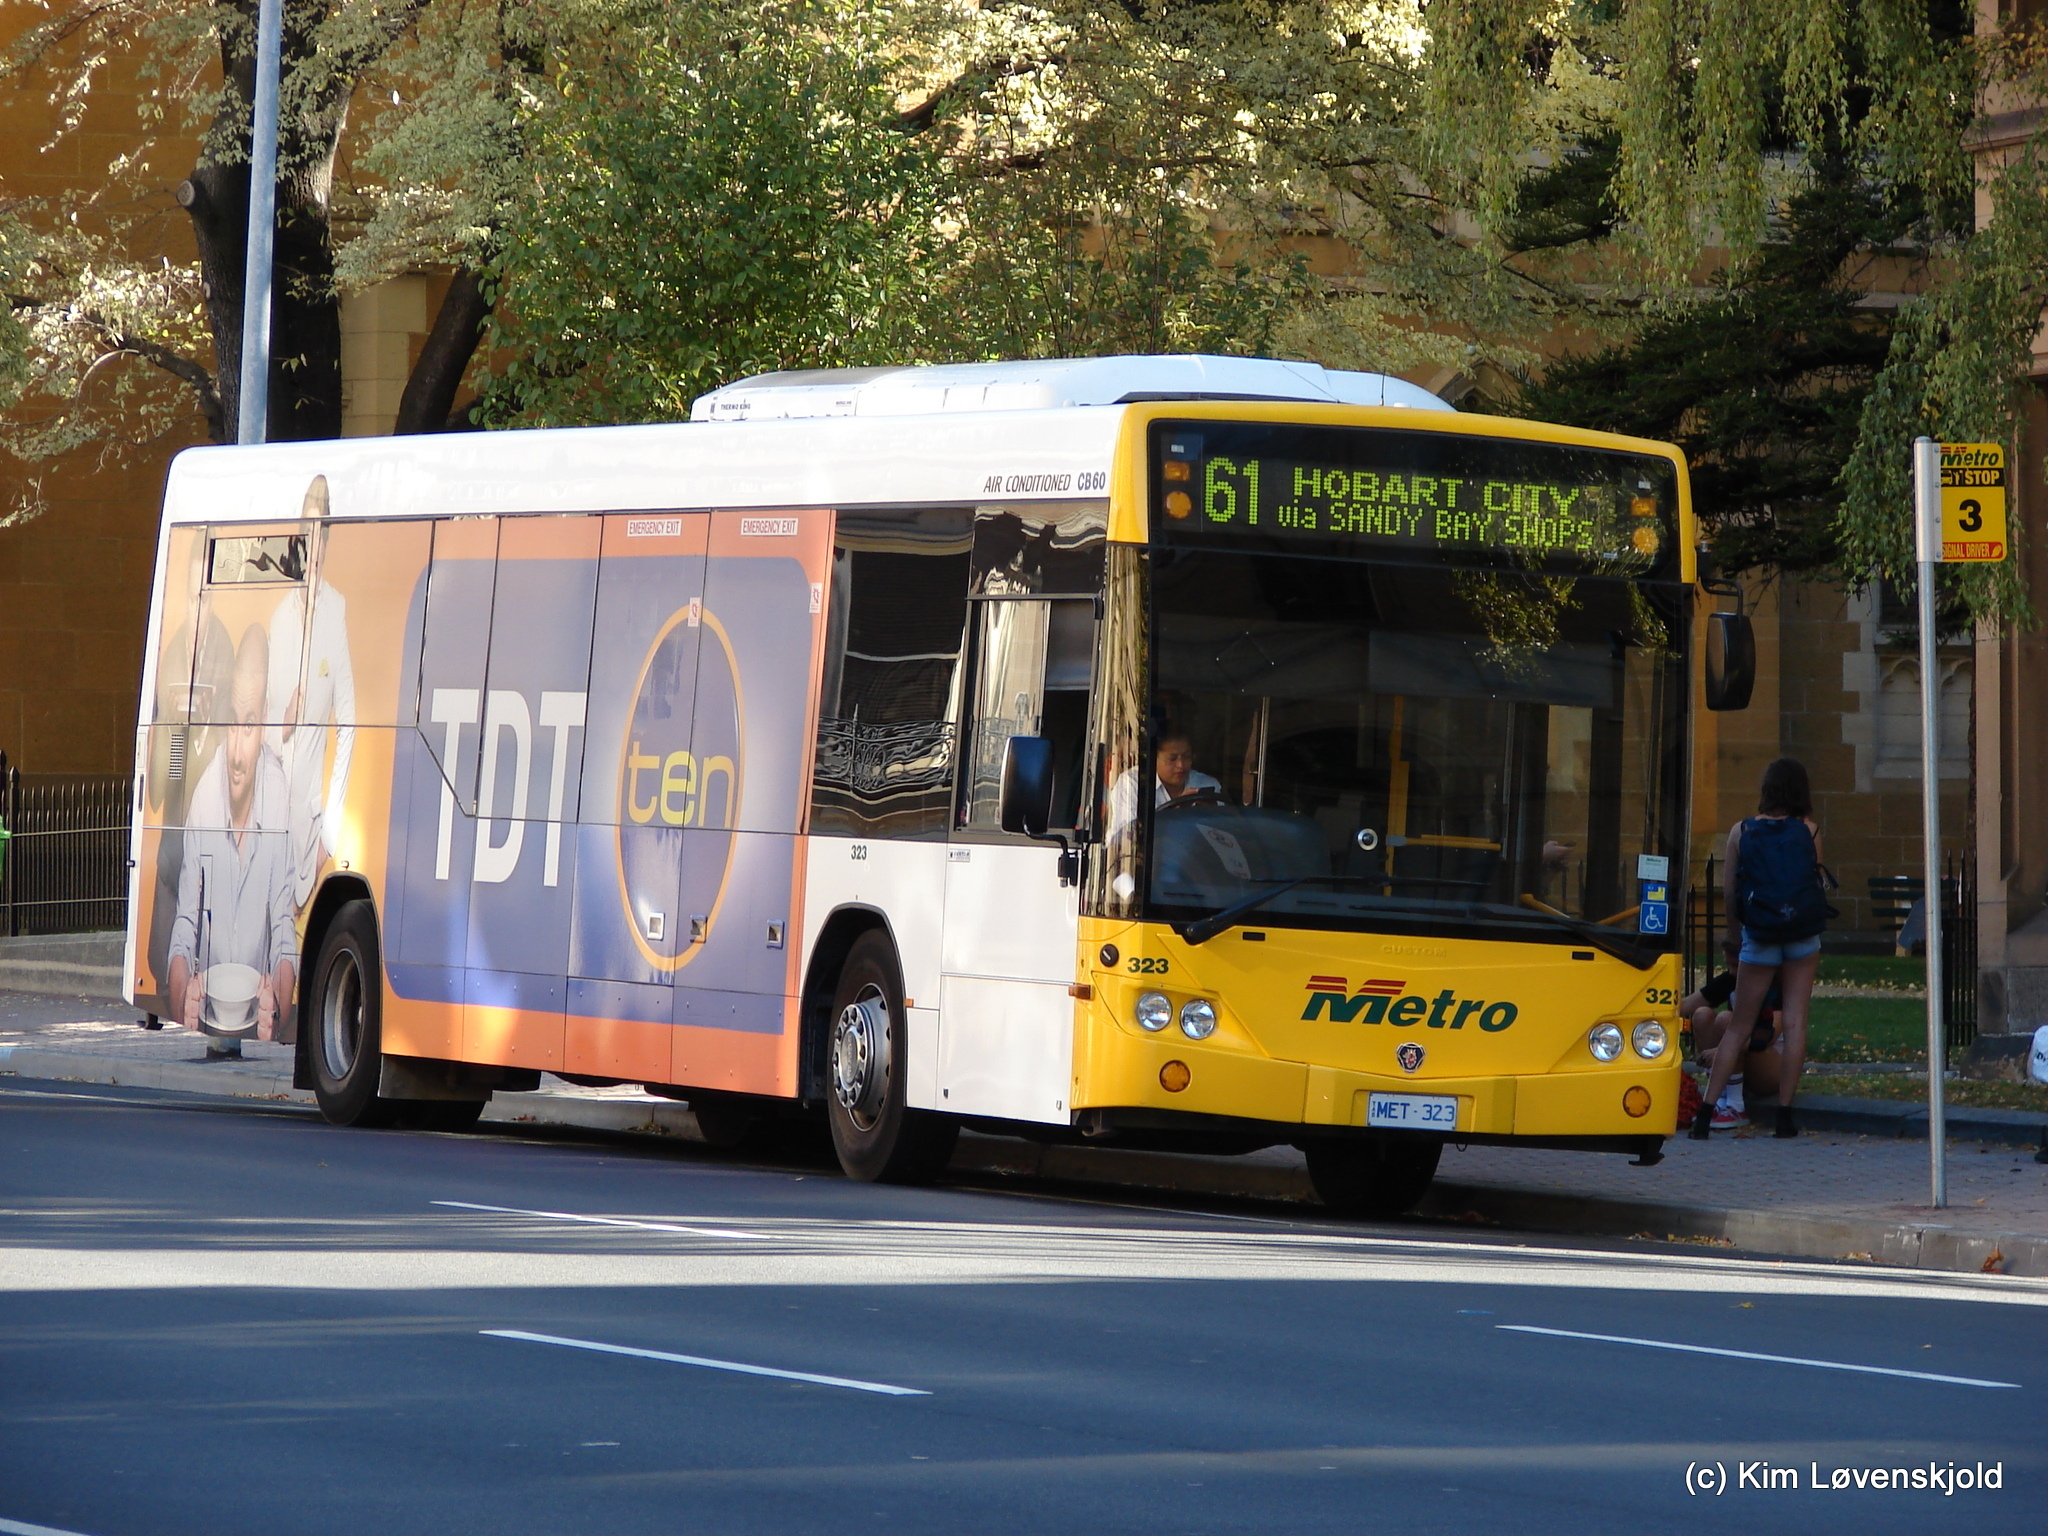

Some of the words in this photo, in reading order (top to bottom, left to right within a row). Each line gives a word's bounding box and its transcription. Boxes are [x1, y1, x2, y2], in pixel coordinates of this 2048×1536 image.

[1941, 446, 1999, 467] Metro
[983, 475, 1003, 493] AIR
[1005, 474, 1071, 492] CONDITIONED
[1077, 471, 1106, 491] CB60
[1965, 470, 2000, 485] STOP
[1205, 457, 1260, 525] 61
[1294, 466, 1464, 508] HOBART
[1484, 481, 1580, 516] CITY
[1278, 498, 1317, 529] via
[1329, 501, 1423, 537] SANDY
[1435, 509, 1492, 542] BAY
[1505, 515, 1594, 550] SHOPS
[1958, 498, 1983, 533] 3
[629, 521, 665, 535] EMERGENCY
[666, 520, 680, 534] EXIT
[742, 520, 781, 534] EMERGENCY
[781, 520, 797, 534] EXIT
[1942, 543, 1965, 558] SIGNAL
[1966, 543, 1990, 557] DRIVER
[431, 689, 587, 887] TDT
[627, 741, 735, 827] ten
[851, 845, 867, 860] 323
[1127, 957, 1170, 975] 323
[1301, 975, 1519, 1033] Metro
